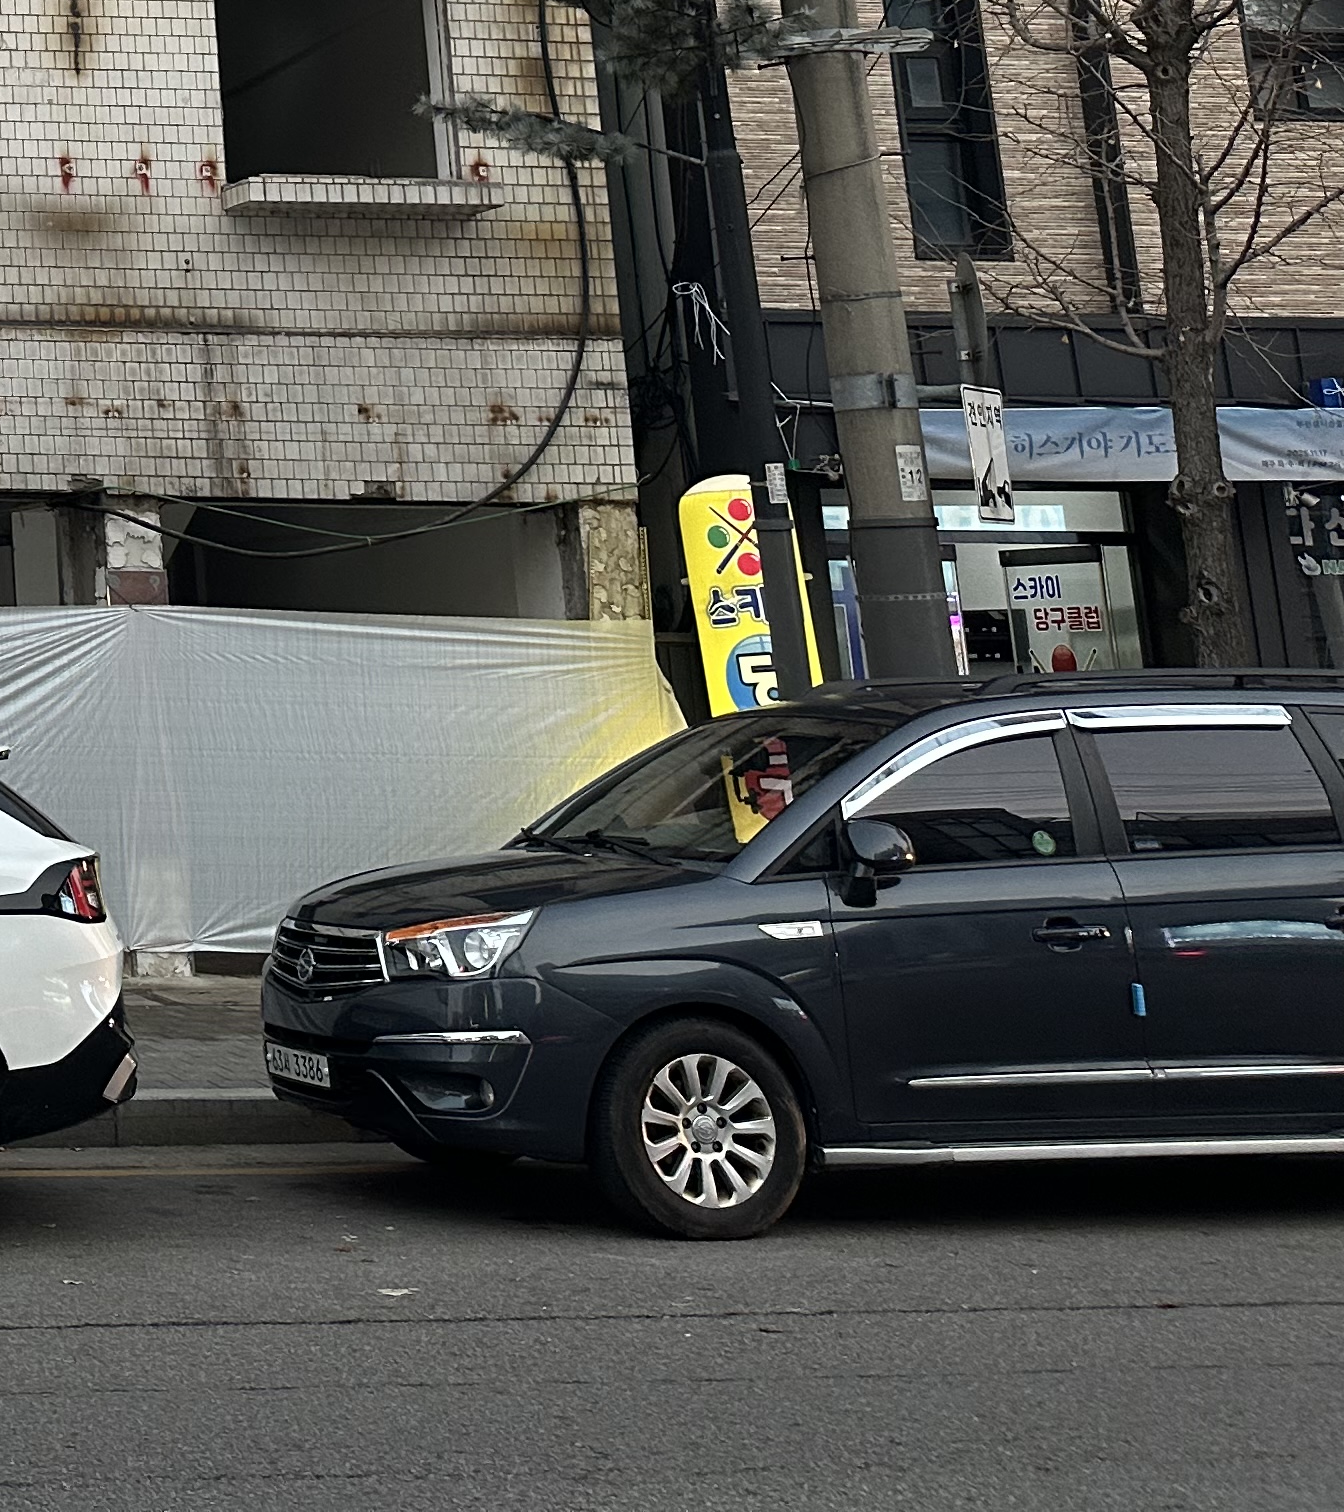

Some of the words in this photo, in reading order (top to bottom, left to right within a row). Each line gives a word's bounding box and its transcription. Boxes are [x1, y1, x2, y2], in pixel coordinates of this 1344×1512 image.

[967, 401, 1003, 431] 견인지역
[1011, 431, 1113, 460] 히스기야
[1012, 574, 1062, 600] 스카이
[1033, 605, 1103, 632] 당구클럽
[293, 1053, 324, 1083] 3386
